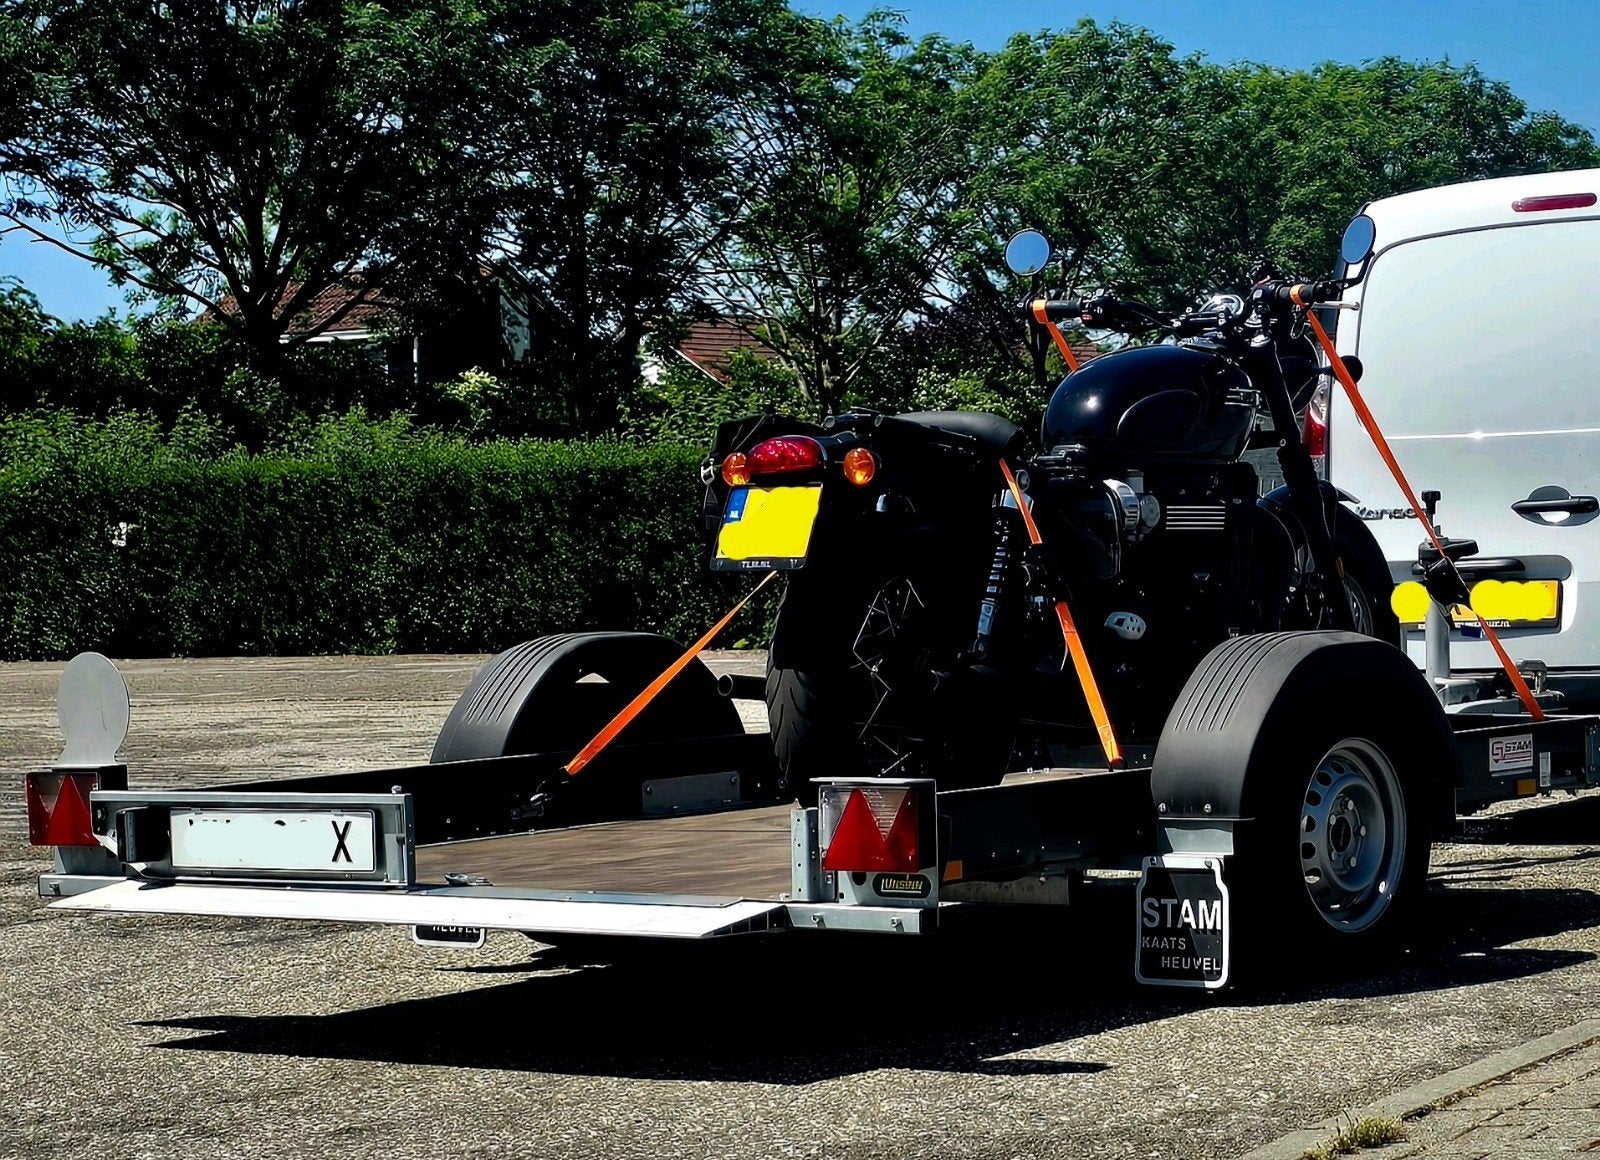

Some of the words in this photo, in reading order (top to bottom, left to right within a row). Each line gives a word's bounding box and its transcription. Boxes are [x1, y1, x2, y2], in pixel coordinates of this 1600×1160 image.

[1505, 740, 1532, 752] STAM
[1143, 897, 1222, 930] STAM
[1142, 936, 1186, 950] KAATS
[1161, 956, 1221, 971] HEUVEL
